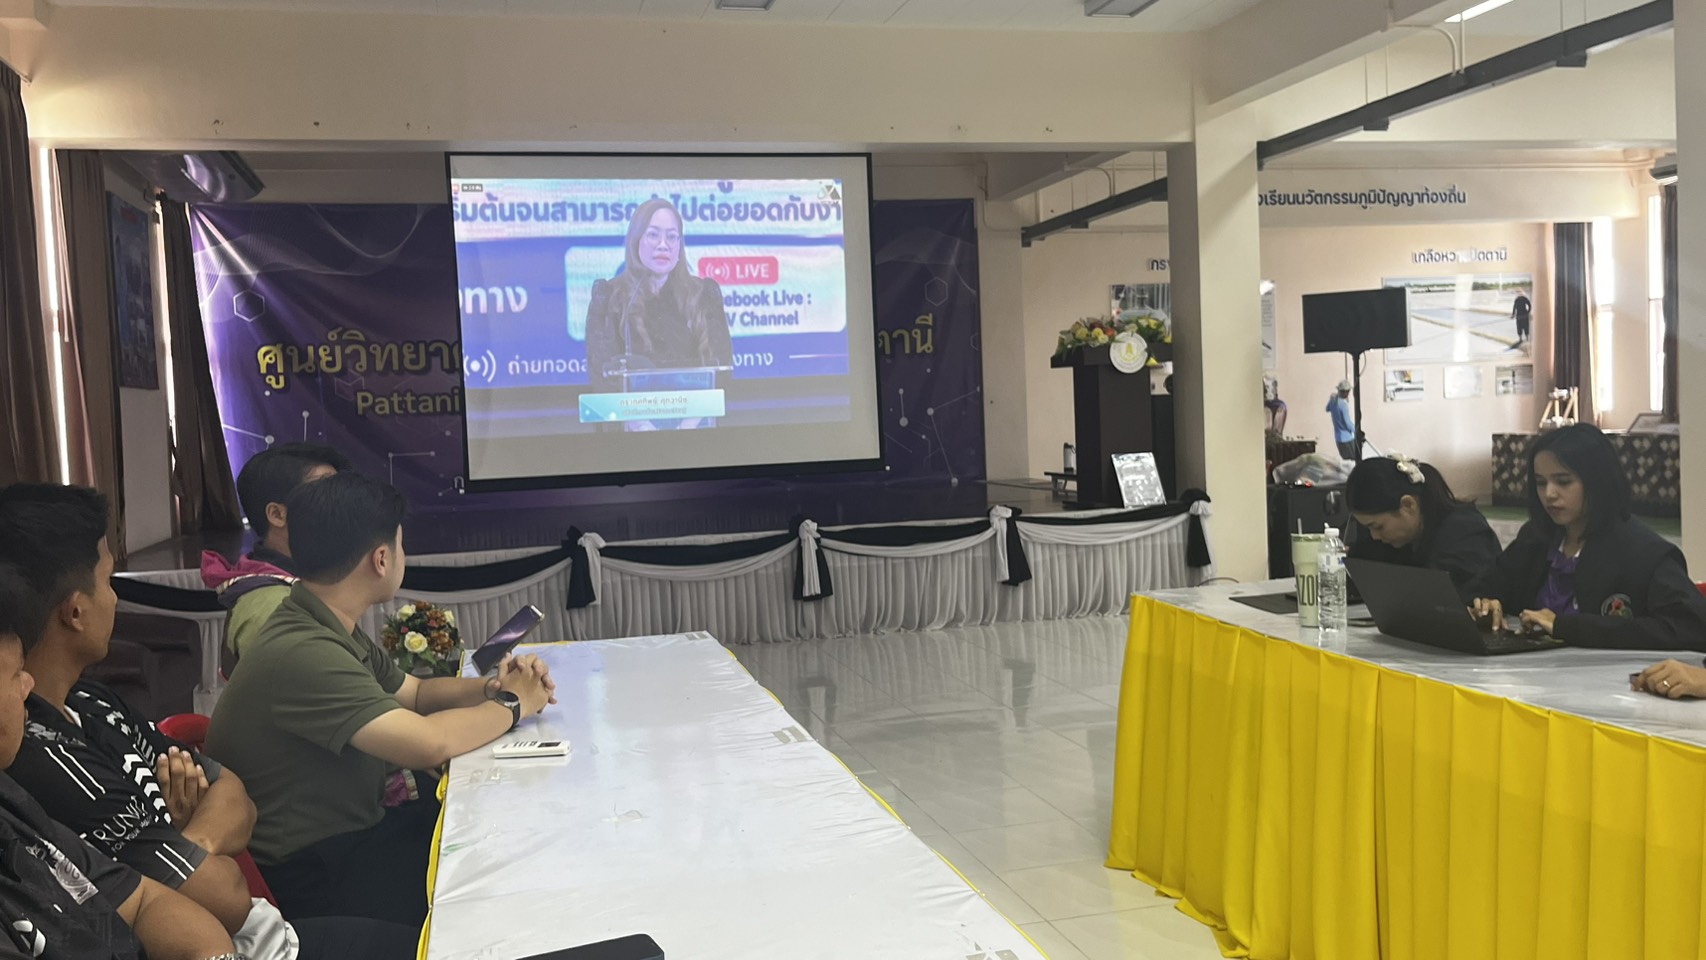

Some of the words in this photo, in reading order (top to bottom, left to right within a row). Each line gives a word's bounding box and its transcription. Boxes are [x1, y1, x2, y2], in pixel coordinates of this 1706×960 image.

[736, 263, 770, 278] LIVE
[459, 286, 528, 314] ทาง
[773, 289, 804, 306] Live
[740, 310, 799, 327] Channel
[257, 327, 460, 389] ศูนย์วิทยา
[356, 388, 460, 415] Pattani
